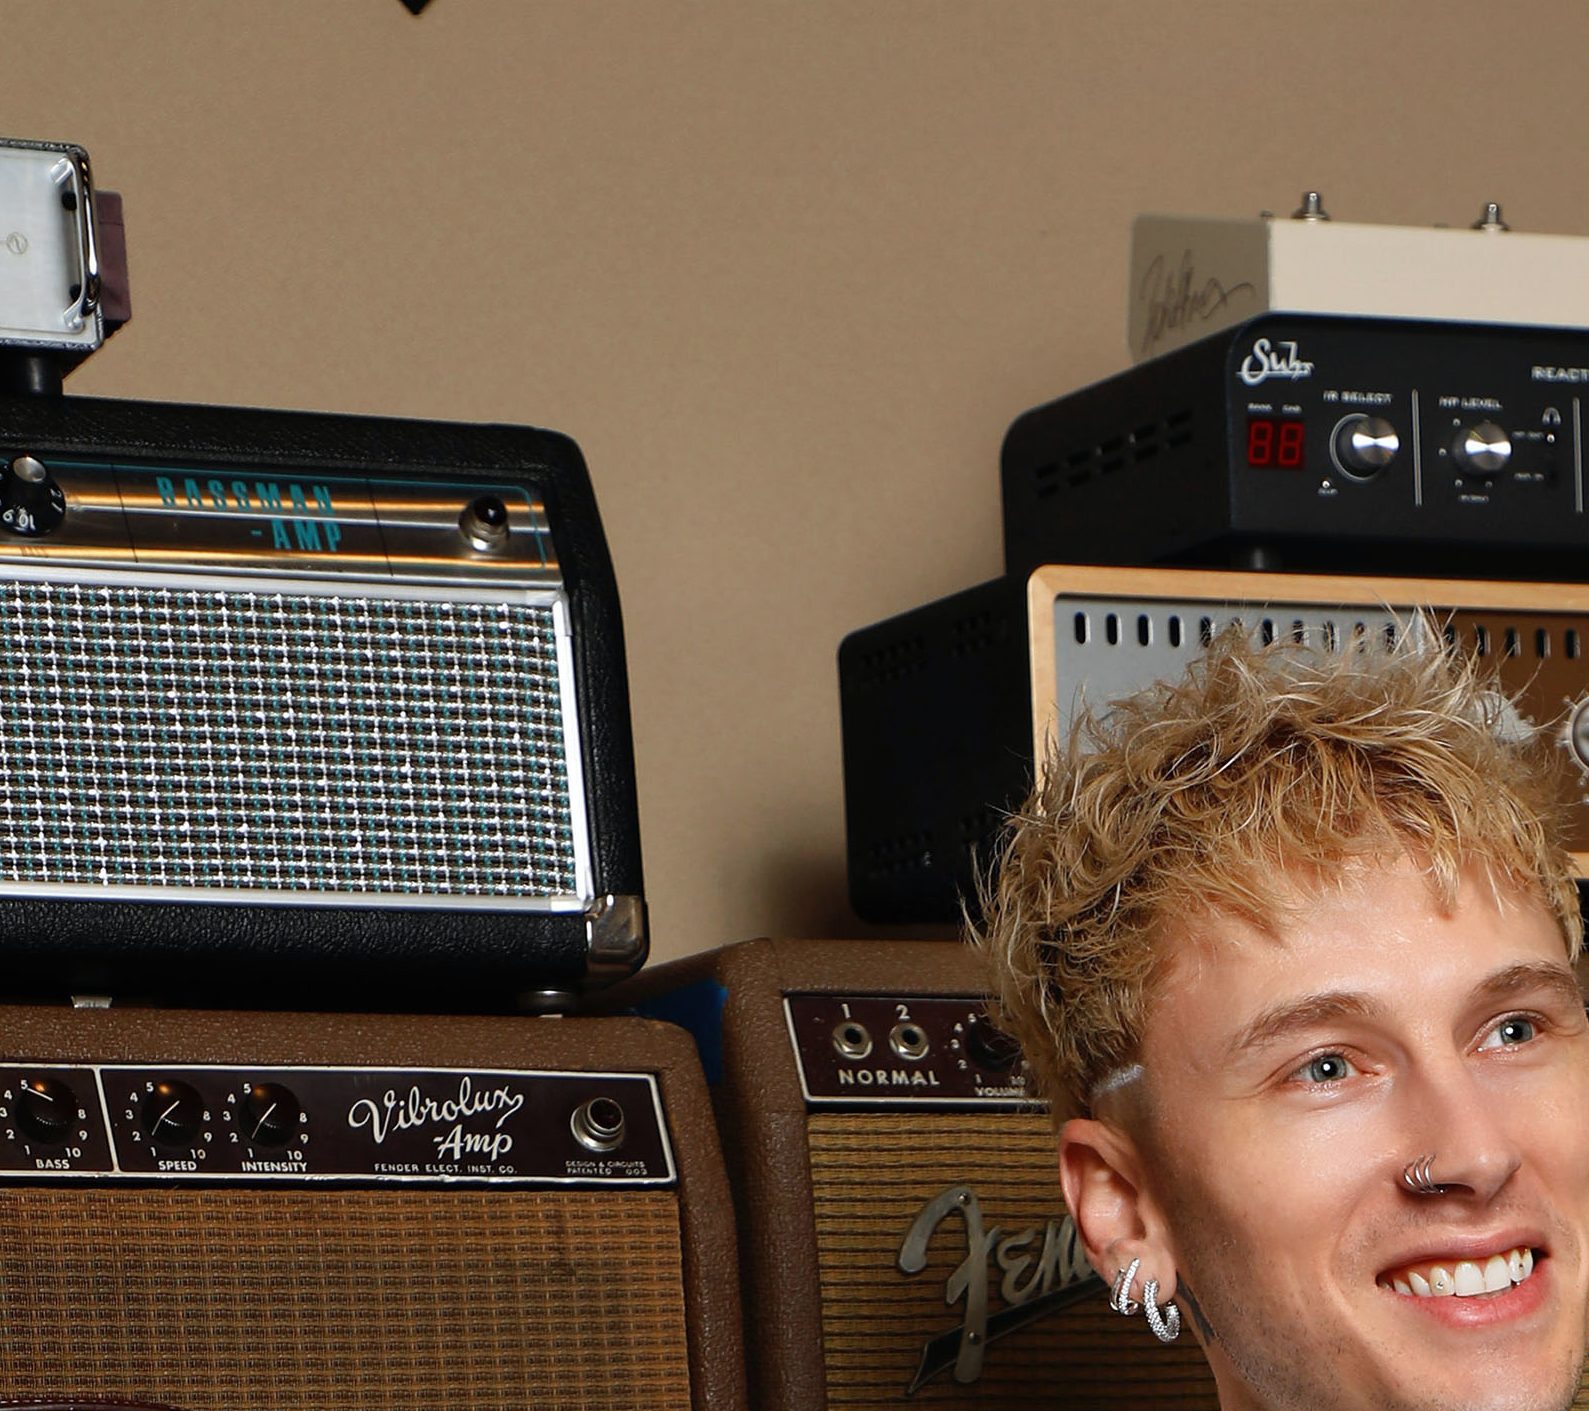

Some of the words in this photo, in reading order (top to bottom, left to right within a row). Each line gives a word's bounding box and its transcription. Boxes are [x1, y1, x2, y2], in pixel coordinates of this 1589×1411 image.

[1249, 420, 1305, 466] 88
[156, 475, 336, 517] BASSMAN
[841, 1003, 852, 1019] 1
[895, 1004, 911, 1021] 2
[838, 1069, 941, 1086] NORMAL
[348, 1076, 524, 1144] Vibrolux
[36, 1158, 70, 1170] BASS
[158, 1160, 198, 1173] SPEED
[242, 1160, 308, 1173] INTENSITY
[374, 1163, 420, 1173] FENDER
[425, 1163, 463, 1174] ELECT.
[467, 1164, 495, 1174] INST.
[498, 1164, 518, 1175] CO.
[567, 1167, 612, 1176] PATENTED
